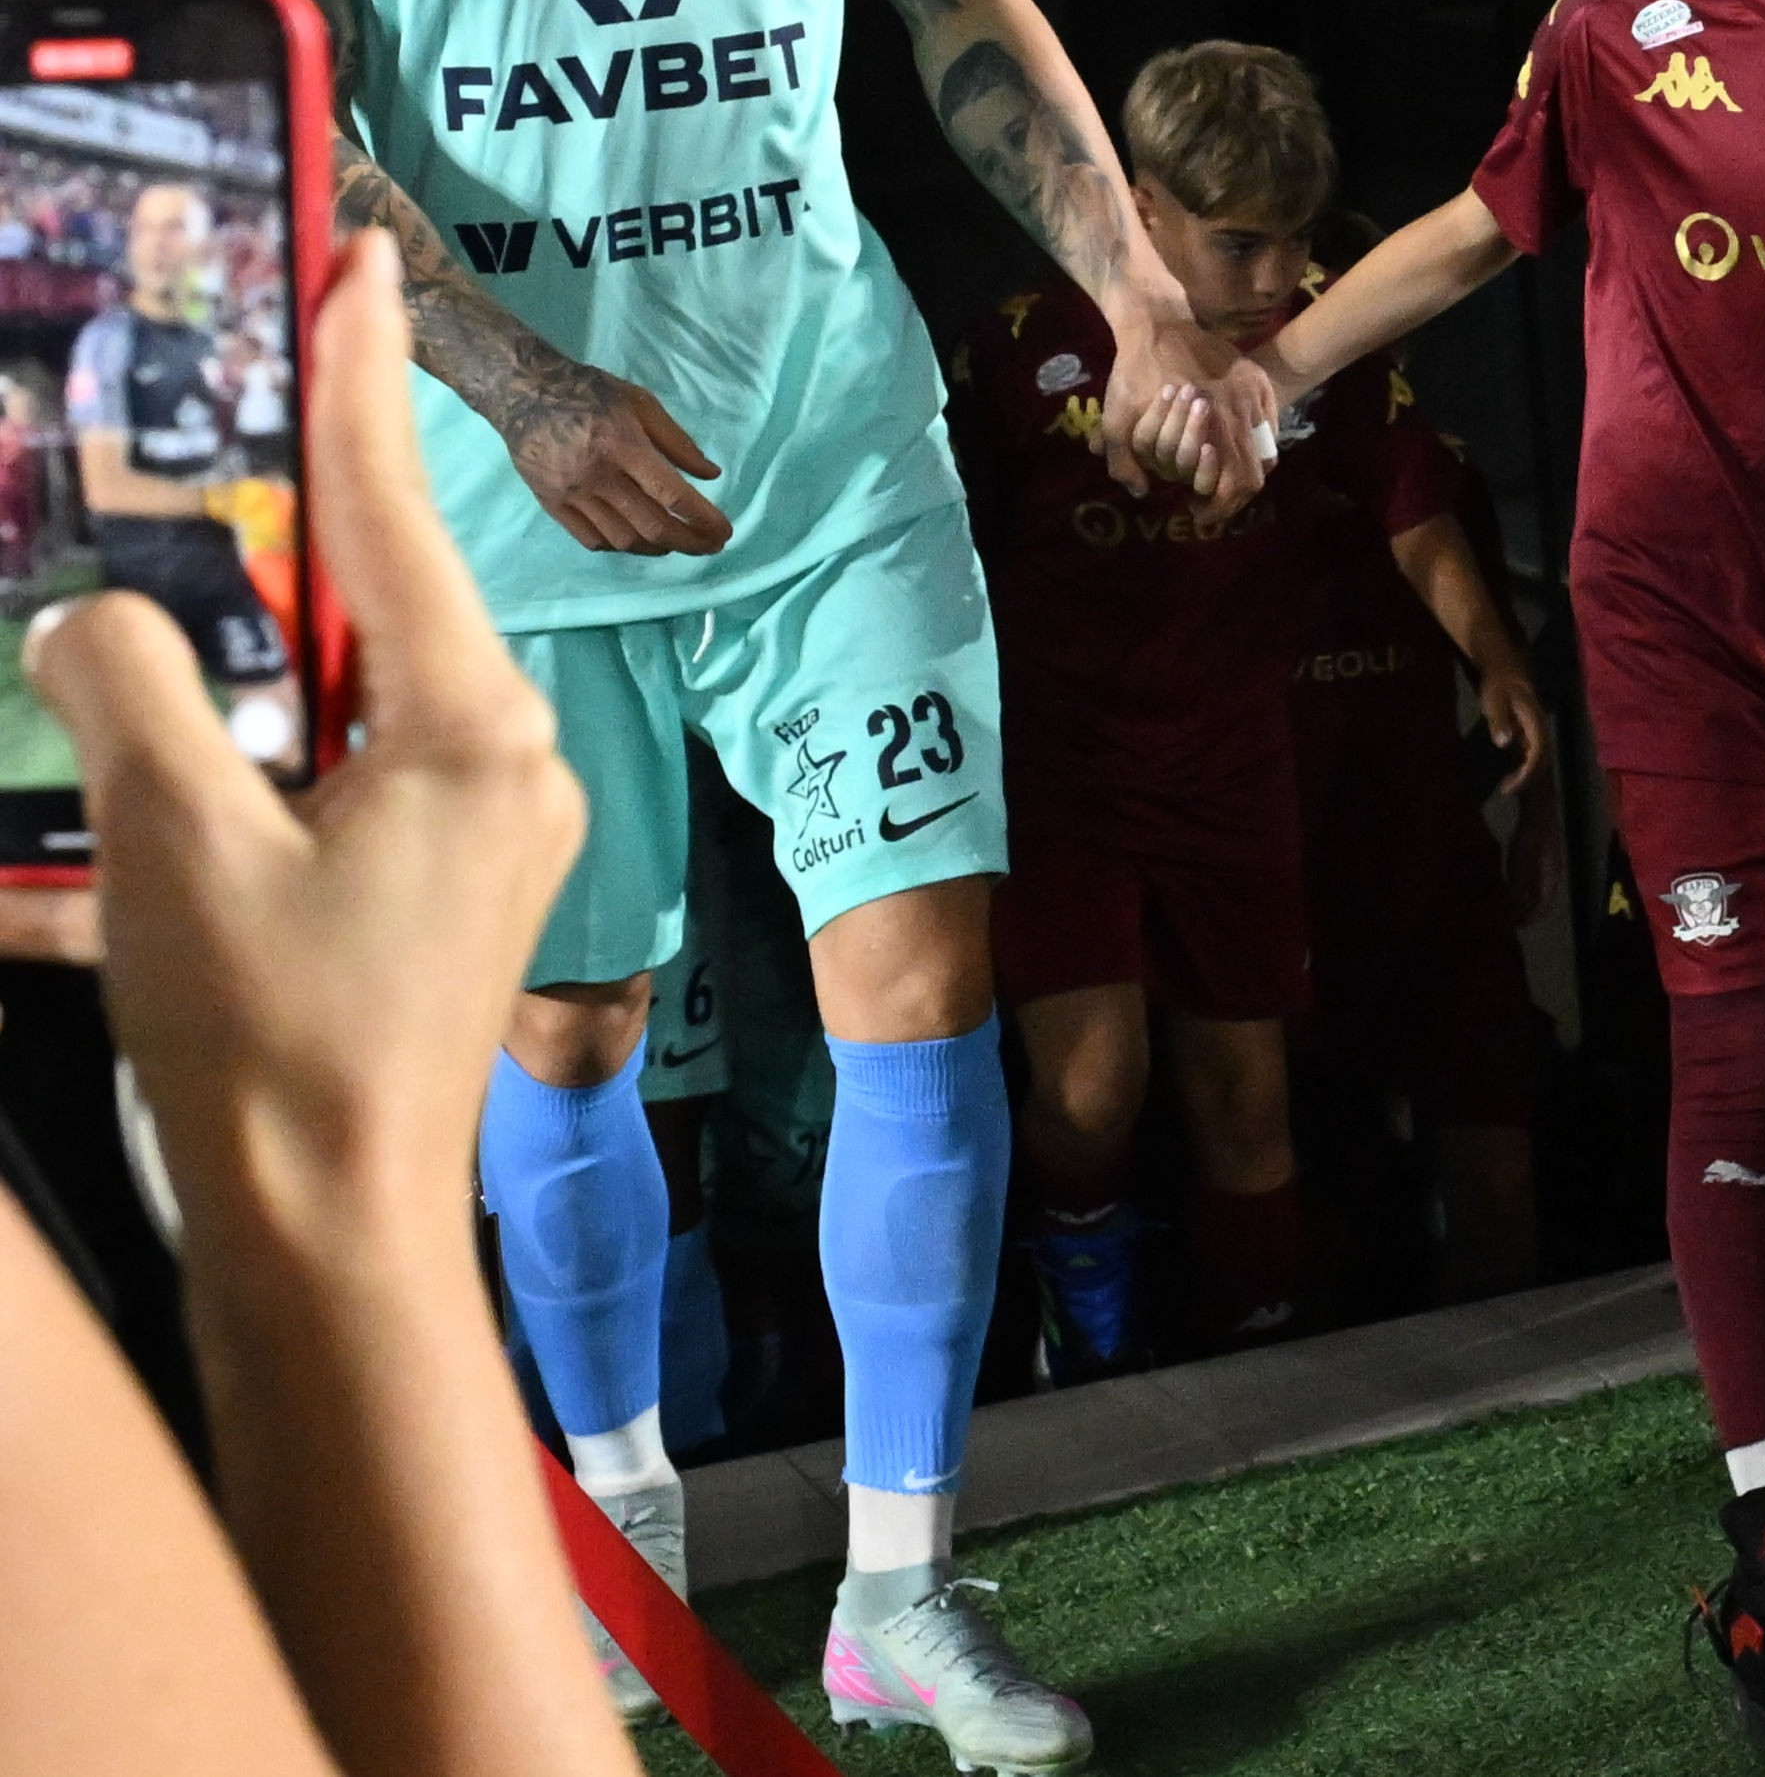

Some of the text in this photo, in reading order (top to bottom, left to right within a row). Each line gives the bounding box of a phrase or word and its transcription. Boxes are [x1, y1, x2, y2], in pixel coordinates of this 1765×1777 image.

[442, 22, 805, 132] FAVBET
[551, 178, 811, 269] VERBIT
[866, 690, 964, 790] 23
